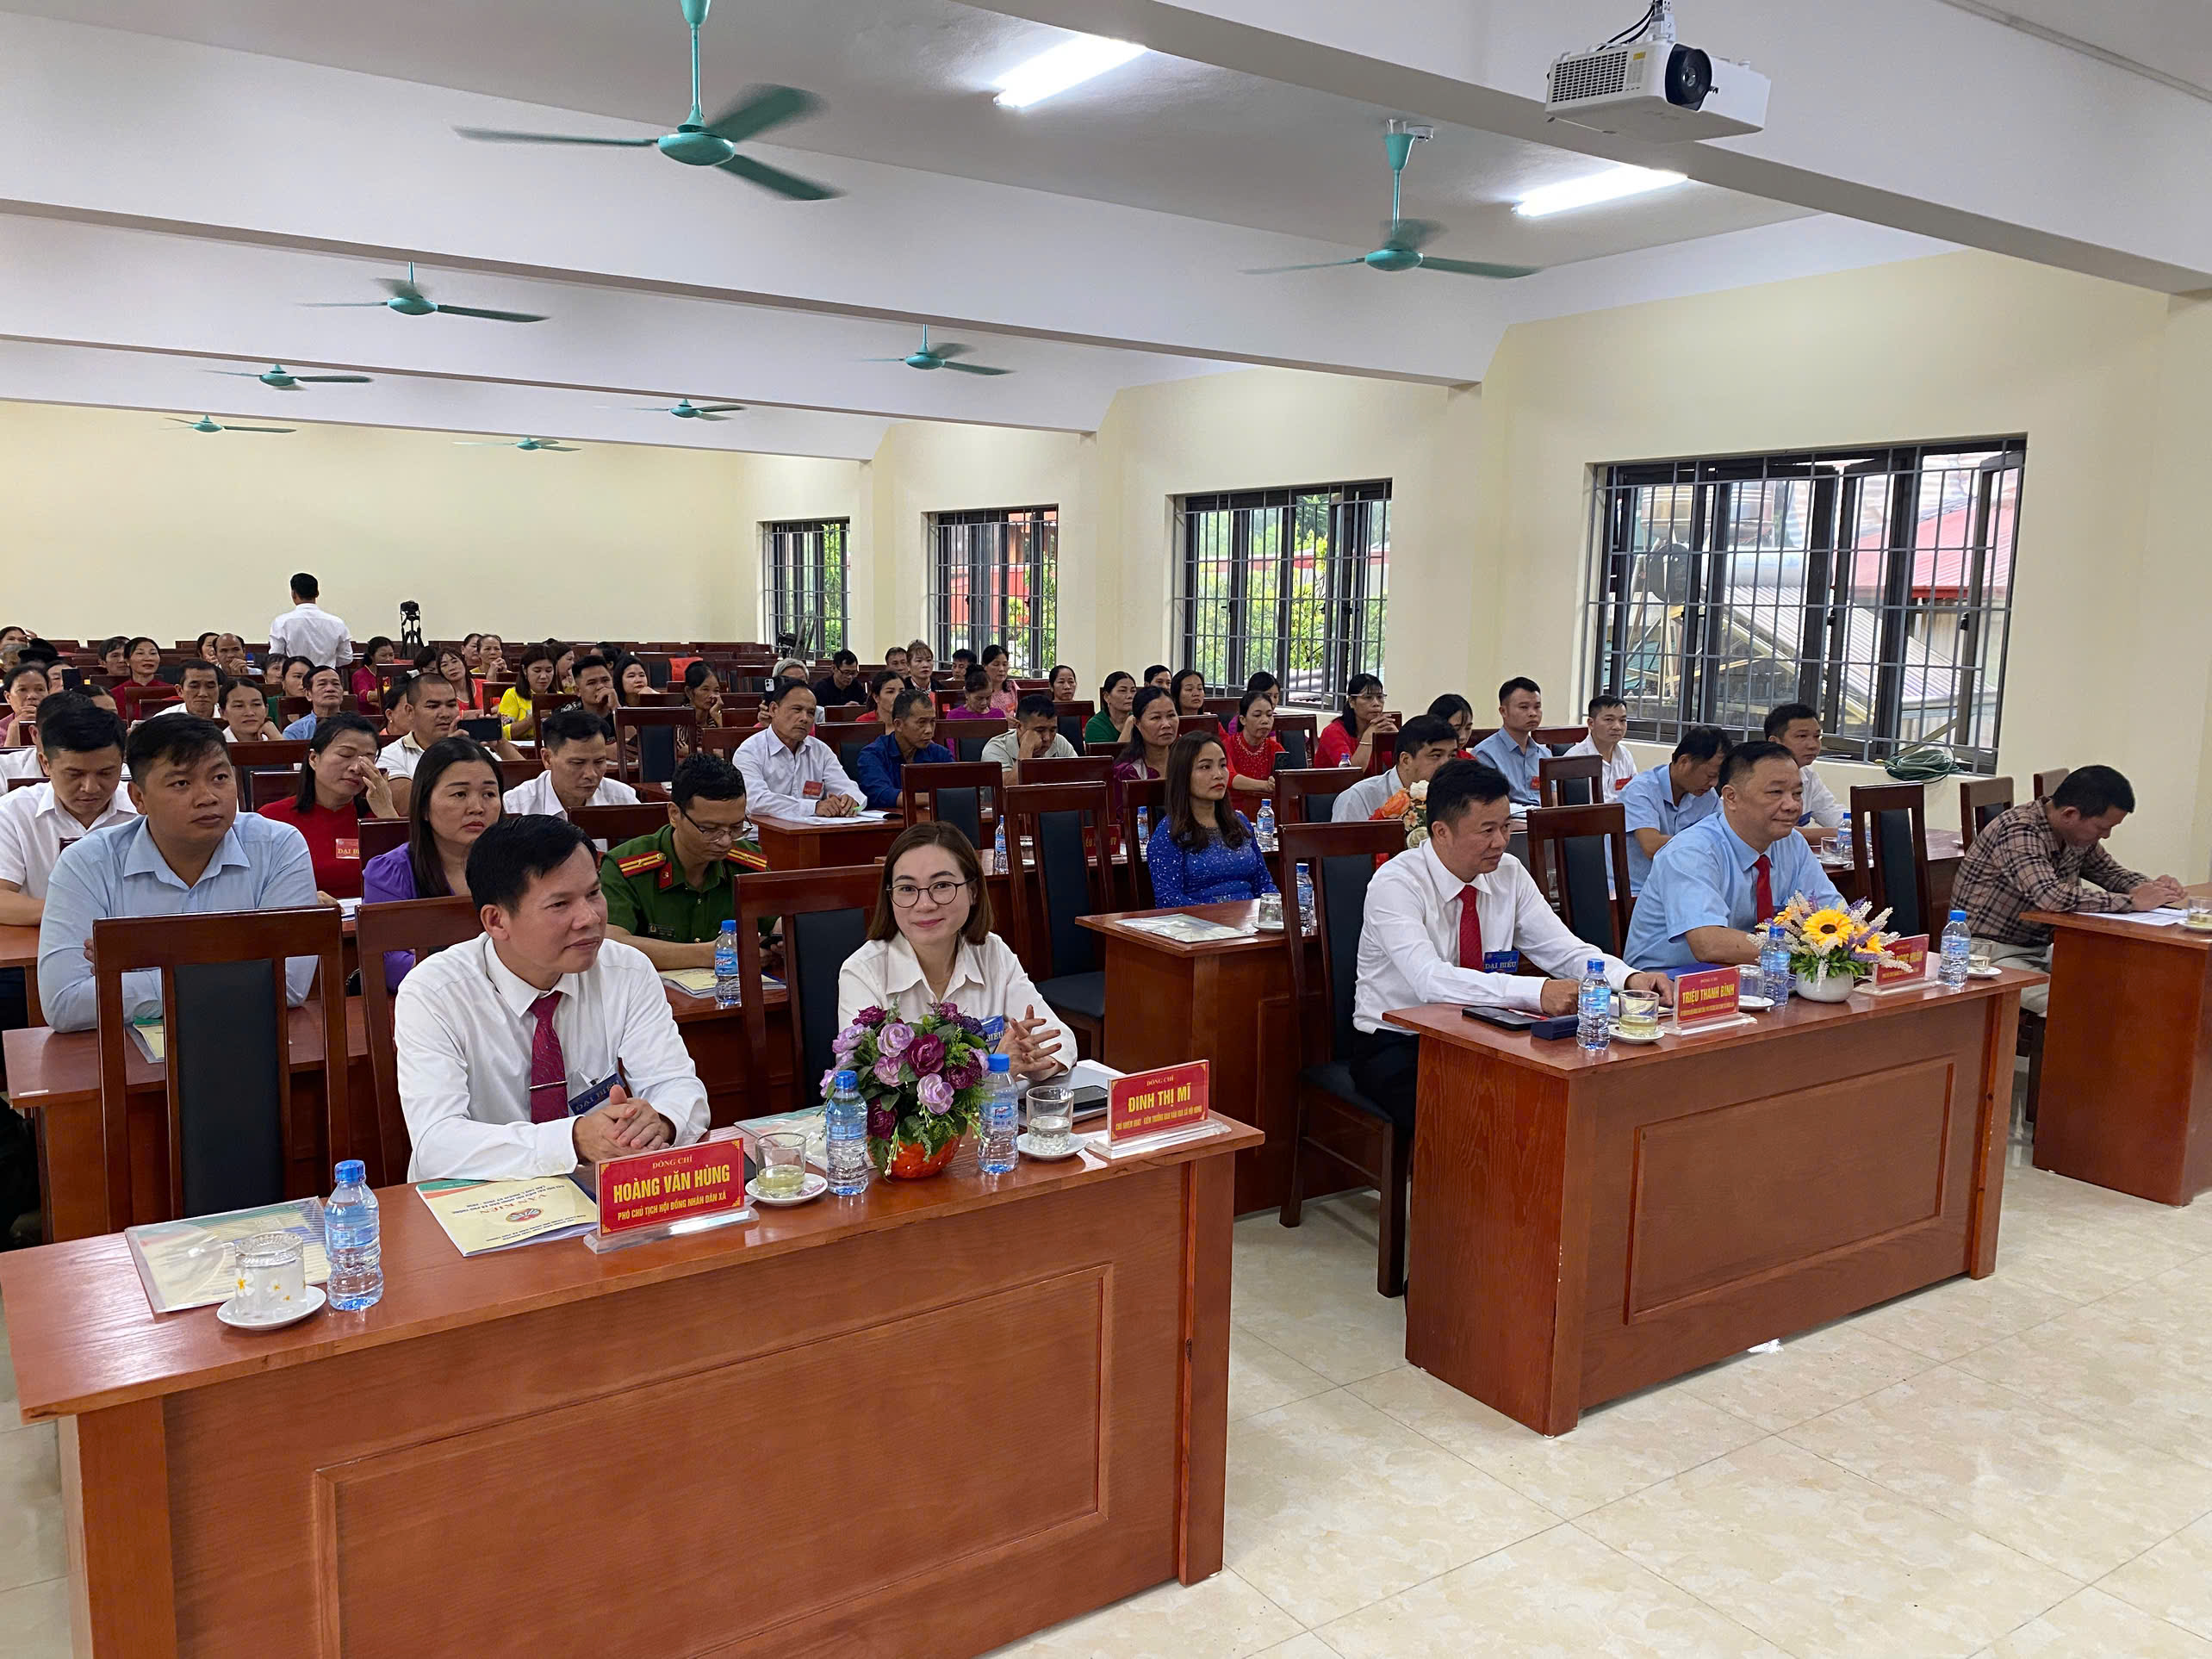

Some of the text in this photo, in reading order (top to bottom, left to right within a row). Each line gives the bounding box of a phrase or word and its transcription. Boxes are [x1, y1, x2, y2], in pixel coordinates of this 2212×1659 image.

[1700, 986, 1720, 1001] THANH
[1128, 1092, 1154, 1113] ĐINH
[1158, 1089, 1174, 1107] THỊ
[677, 1155, 693, 1165] CHÍ
[613, 1164, 730, 1203] HOÀNG VĂN HÙNG
[645, 1205, 658, 1216] TỊCH
[659, 1202, 669, 1213] HỘI
[687, 1195, 704, 1206] NHÂN
[718, 1190, 727, 1201] XÃ
